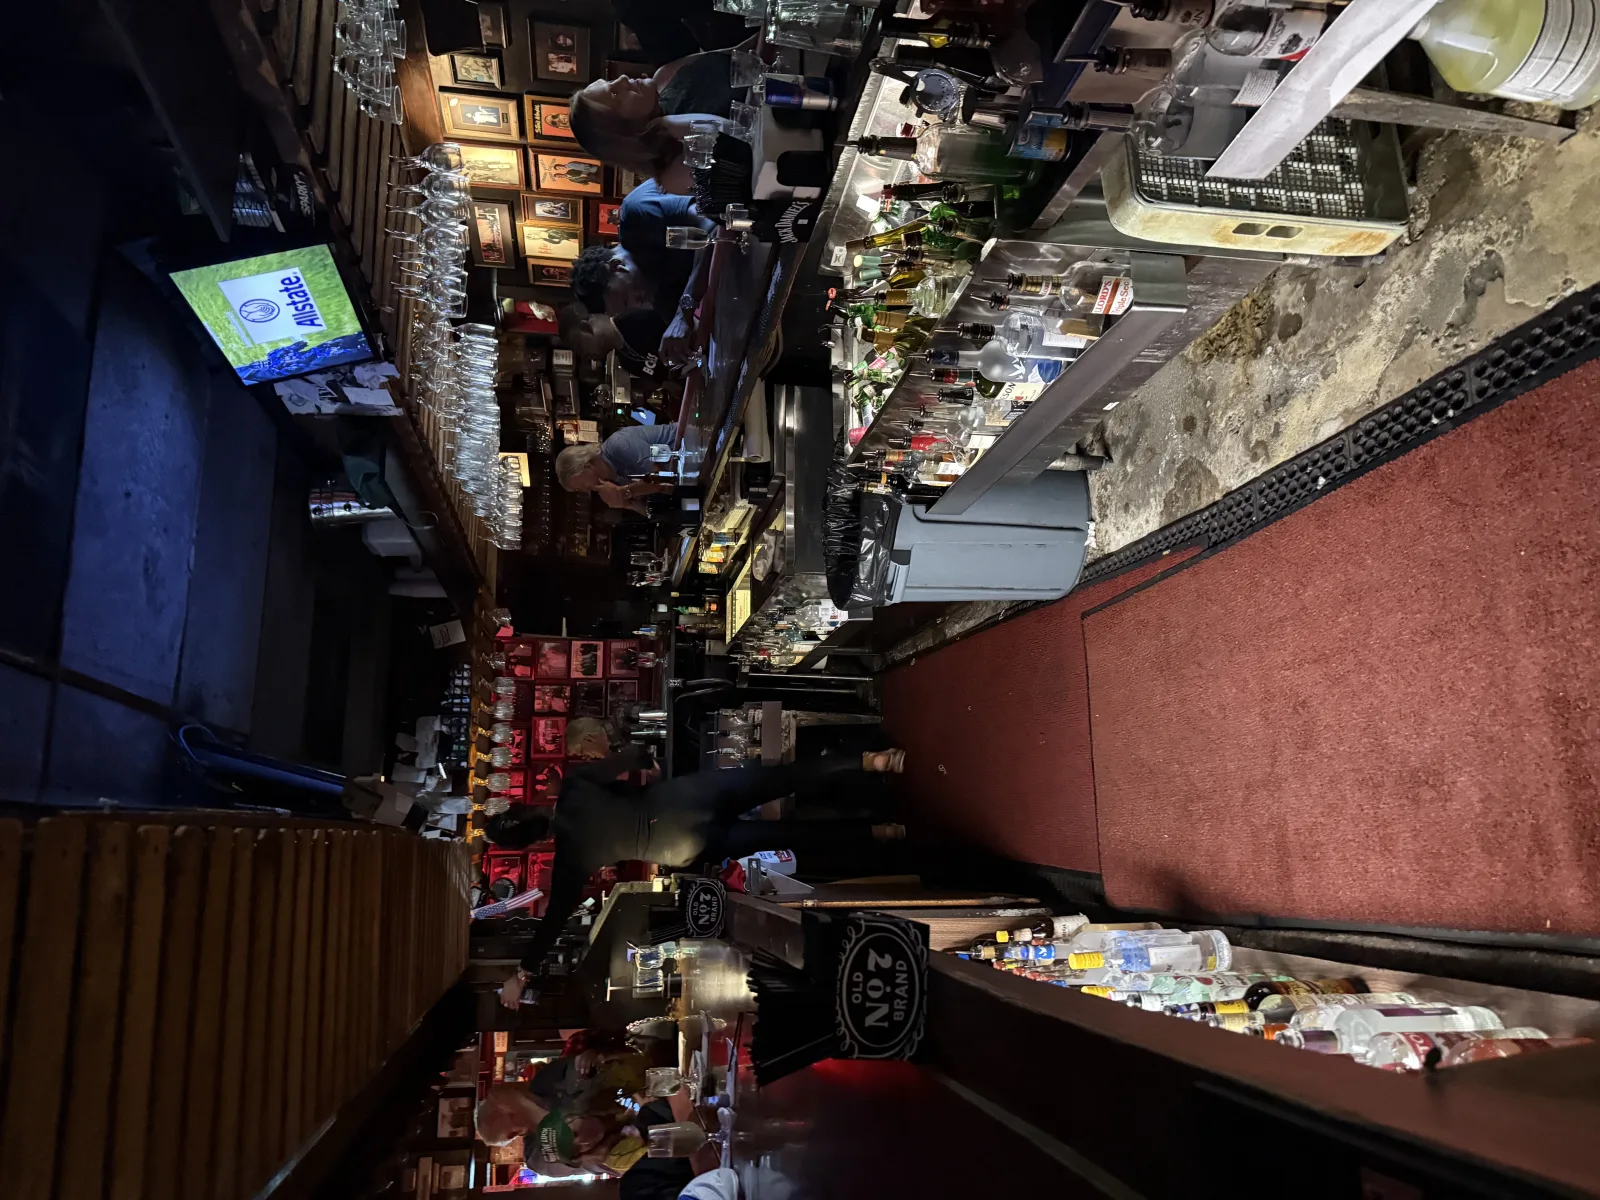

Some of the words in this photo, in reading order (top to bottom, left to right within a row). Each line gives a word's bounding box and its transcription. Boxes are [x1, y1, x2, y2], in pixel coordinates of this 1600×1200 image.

[774, 200, 812, 227] DANIEL'S
[778, 227, 798, 243] JACK
[279, 276, 322, 327] Allstate
[1120, 281, 1129, 297] Sec
[710, 896, 718, 922] BRAND
[867, 948, 892, 972] 7
[851, 972, 863, 1004] OLD
[893, 960, 908, 1021] BRAND
